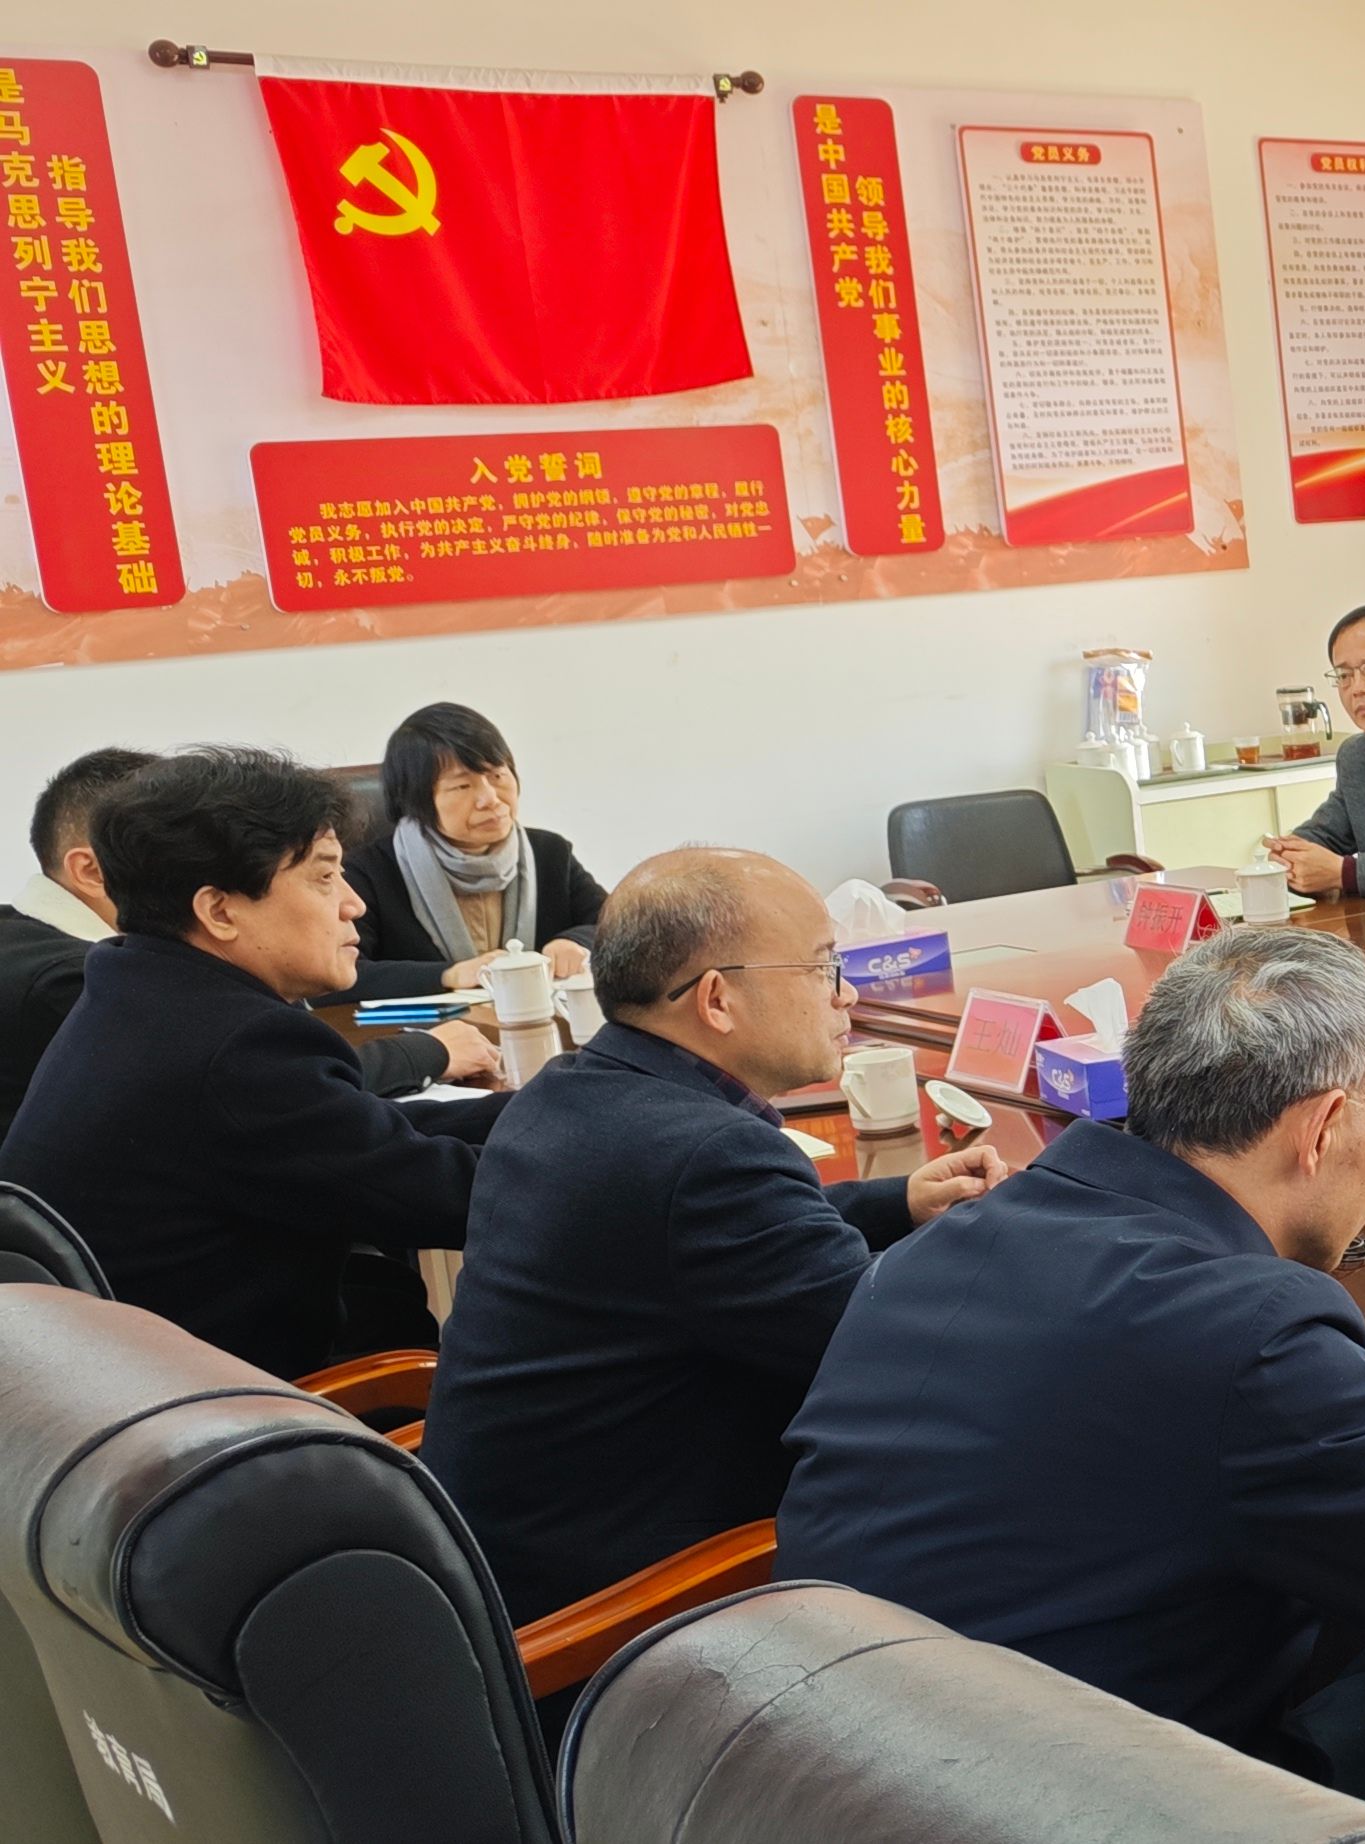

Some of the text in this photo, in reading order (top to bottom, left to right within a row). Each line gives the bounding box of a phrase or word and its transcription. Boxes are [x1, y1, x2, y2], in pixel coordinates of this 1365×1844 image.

[812, 104, 865, 310] 是中国共产党
[1031, 144, 1090, 162] 党员义务
[0, 67, 75, 394] 是马克思列宁主义
[47, 154, 158, 595] 指导我们思想的理论基础
[855, 174, 928, 545] 领导我们事业的核心力量
[468, 451, 604, 486] 入党誓词
[868, 952, 912, 974] C&S
[965, 1016, 1021, 1058] 王灿
